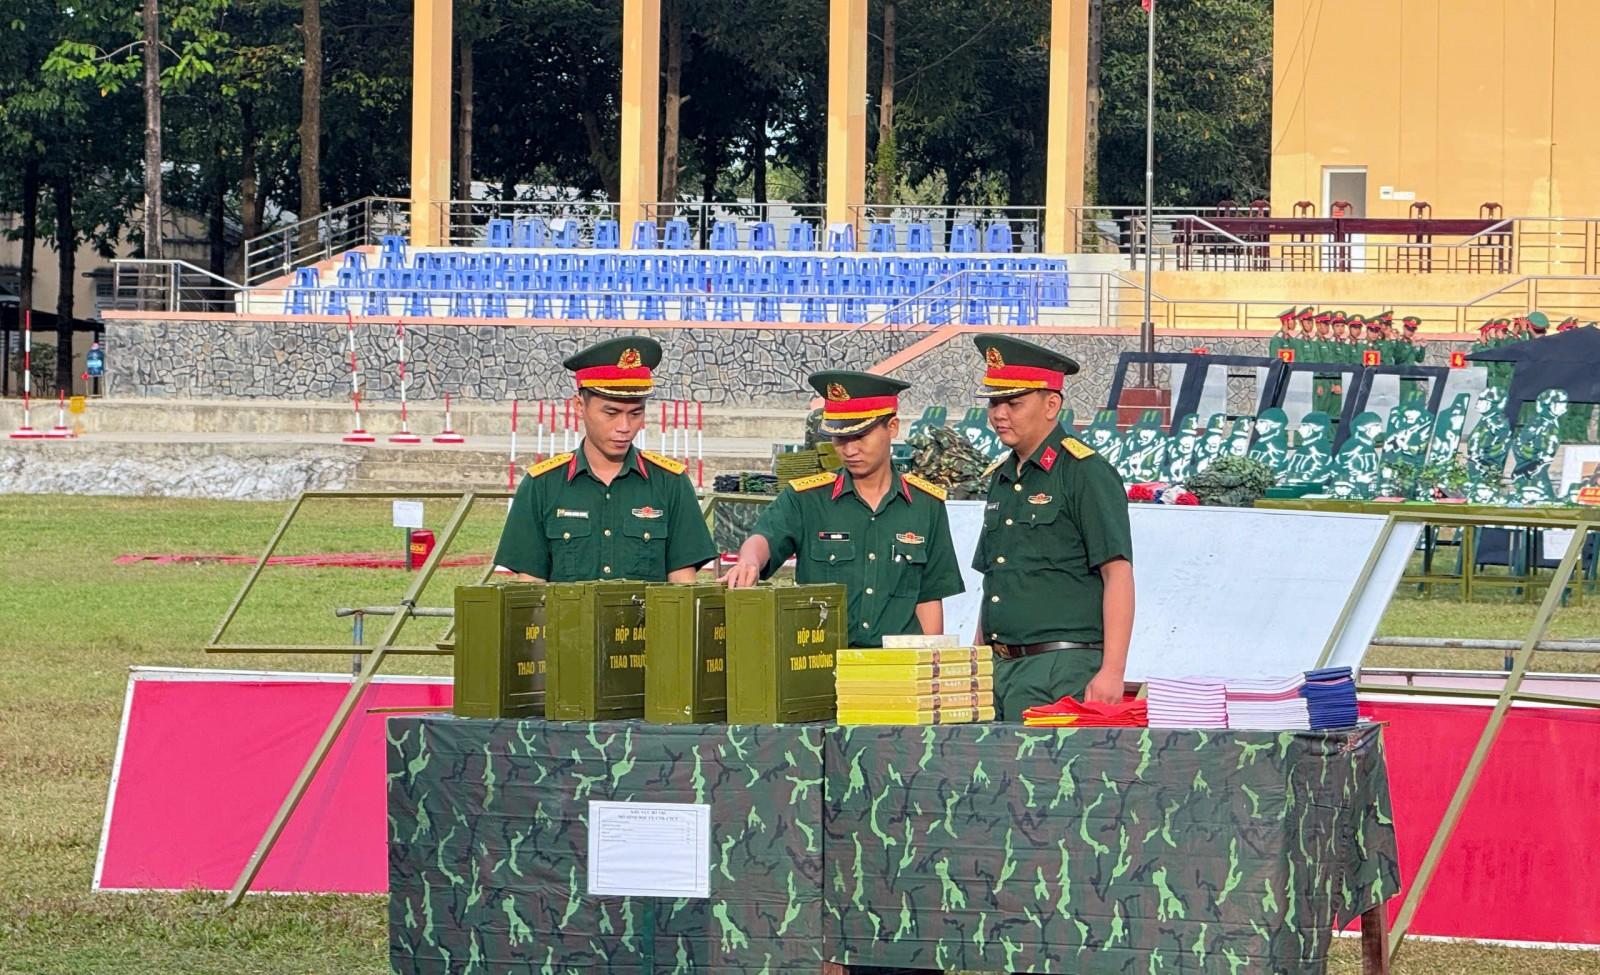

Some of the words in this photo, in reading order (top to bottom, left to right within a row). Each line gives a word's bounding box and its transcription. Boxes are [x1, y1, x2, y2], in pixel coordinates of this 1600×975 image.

[1368, 353, 1376, 366] 3
[1454, 353, 1463, 366] 4
[525, 623, 540, 643] HỘP
[615, 624, 630, 644] HỘP
[797, 627, 810, 647] HỘP
[517, 661, 535, 676] THAO
[609, 655, 628, 669] THAO
[706, 658, 724, 673] THAO
[790, 655, 807, 671] THAO
